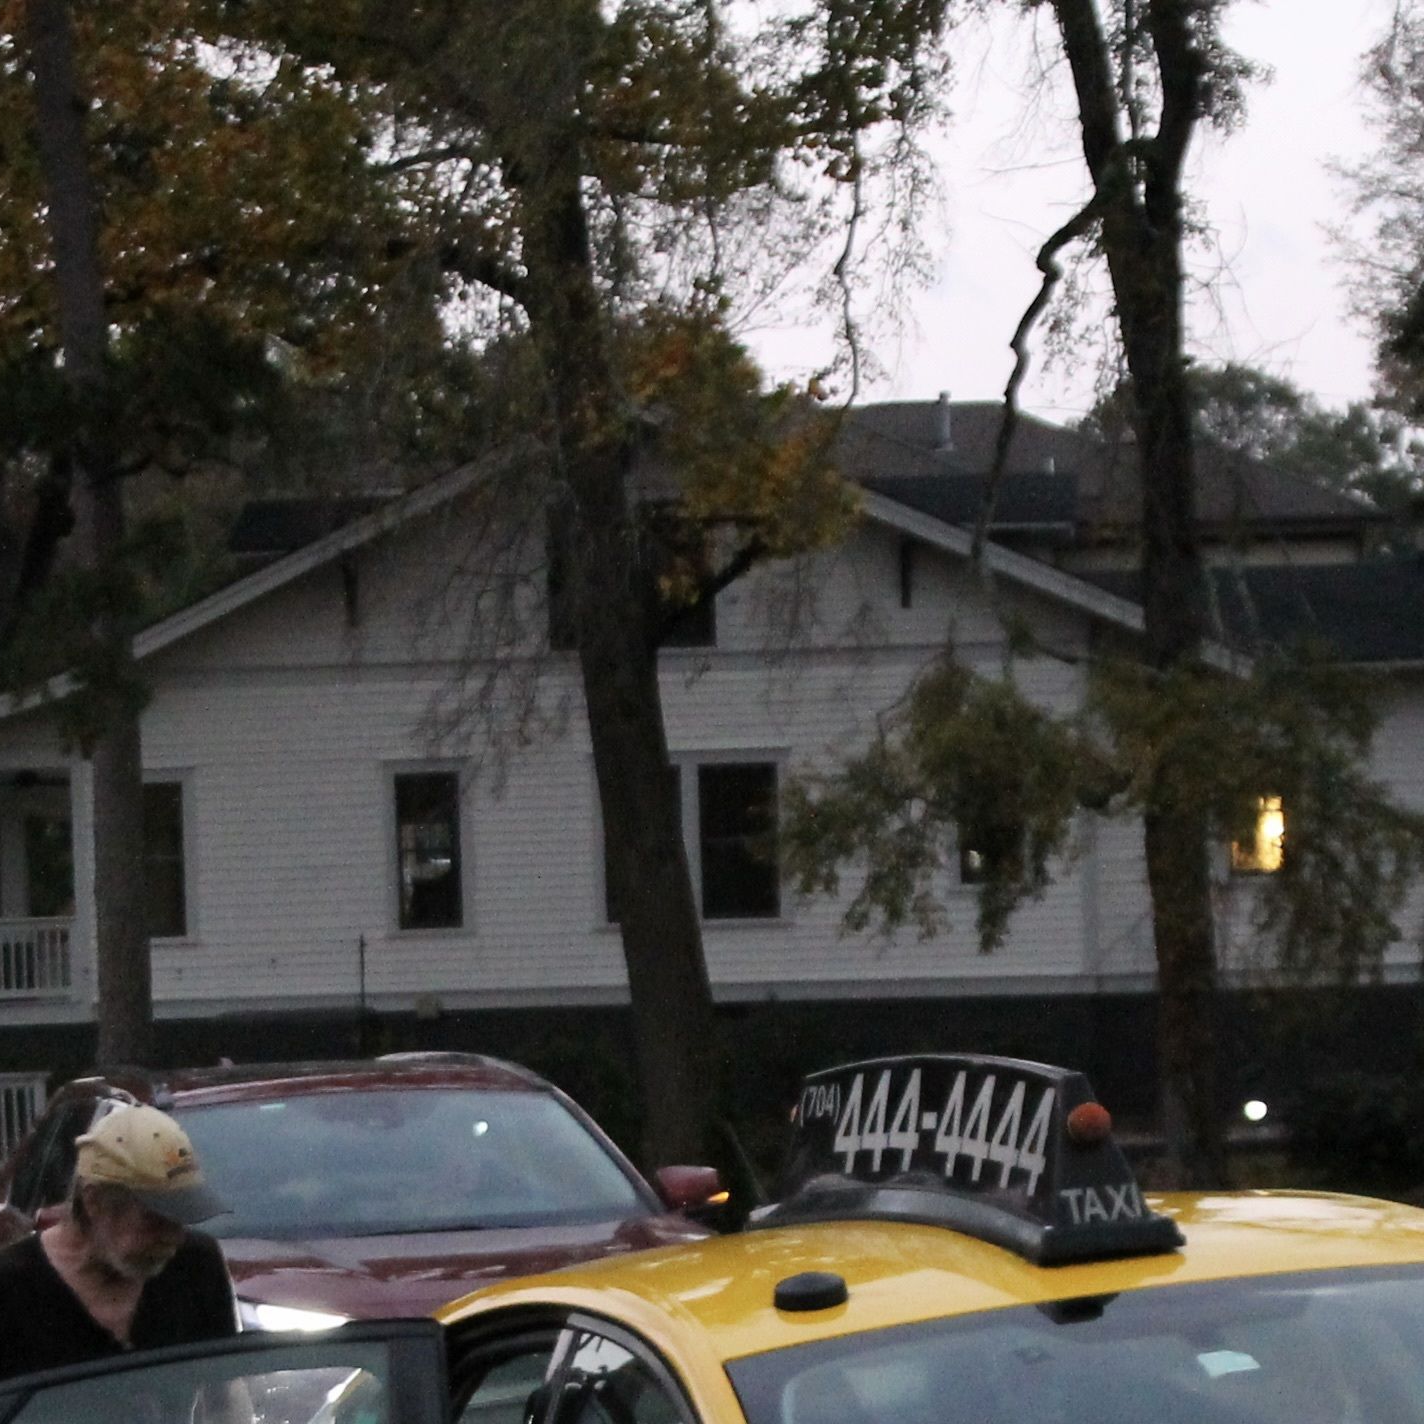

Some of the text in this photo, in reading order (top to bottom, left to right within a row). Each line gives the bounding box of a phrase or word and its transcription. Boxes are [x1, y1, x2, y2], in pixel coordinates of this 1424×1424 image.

[799, 1068, 1057, 1197] (704) 444-4444
[1061, 1182, 1143, 1226] TAXI
